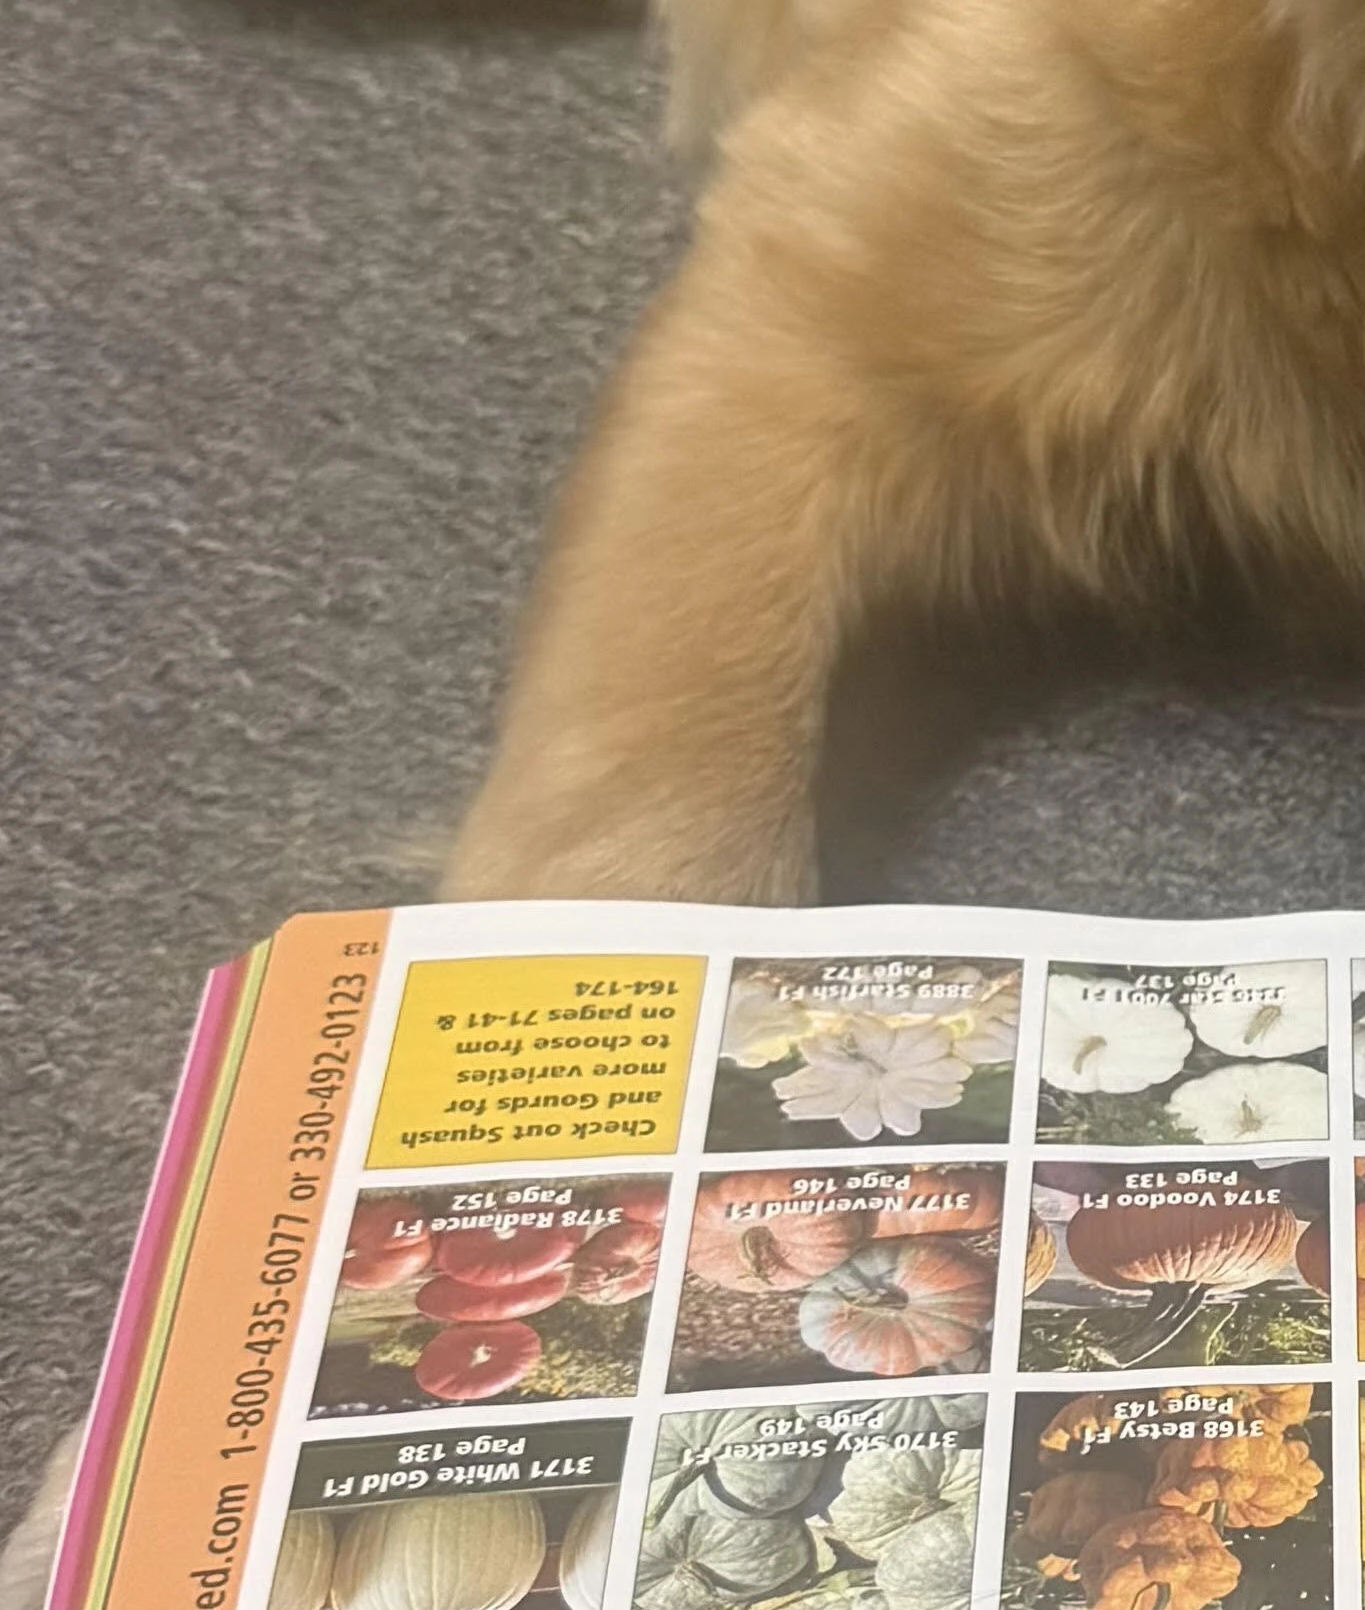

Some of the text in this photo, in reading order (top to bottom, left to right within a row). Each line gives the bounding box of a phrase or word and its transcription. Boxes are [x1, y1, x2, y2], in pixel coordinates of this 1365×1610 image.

[344, 941, 382, 957] 123
[286, 971, 368, 1165] 330-492-0123
[444, 1091, 662, 1116] and Gourds for
[401, 1119, 656, 1149] Check out Squash
[288, 1171, 318, 1203] or
[451, 1186, 572, 1211] Page 152
[394, 1207, 624, 1237] 3178 Radiance F1
[220, 1207, 308, 1463] 1-800-435-6077
[398, 1435, 526, 1464] Page 138
[323, 1456, 594, 1497] 3171 White Gold F1
